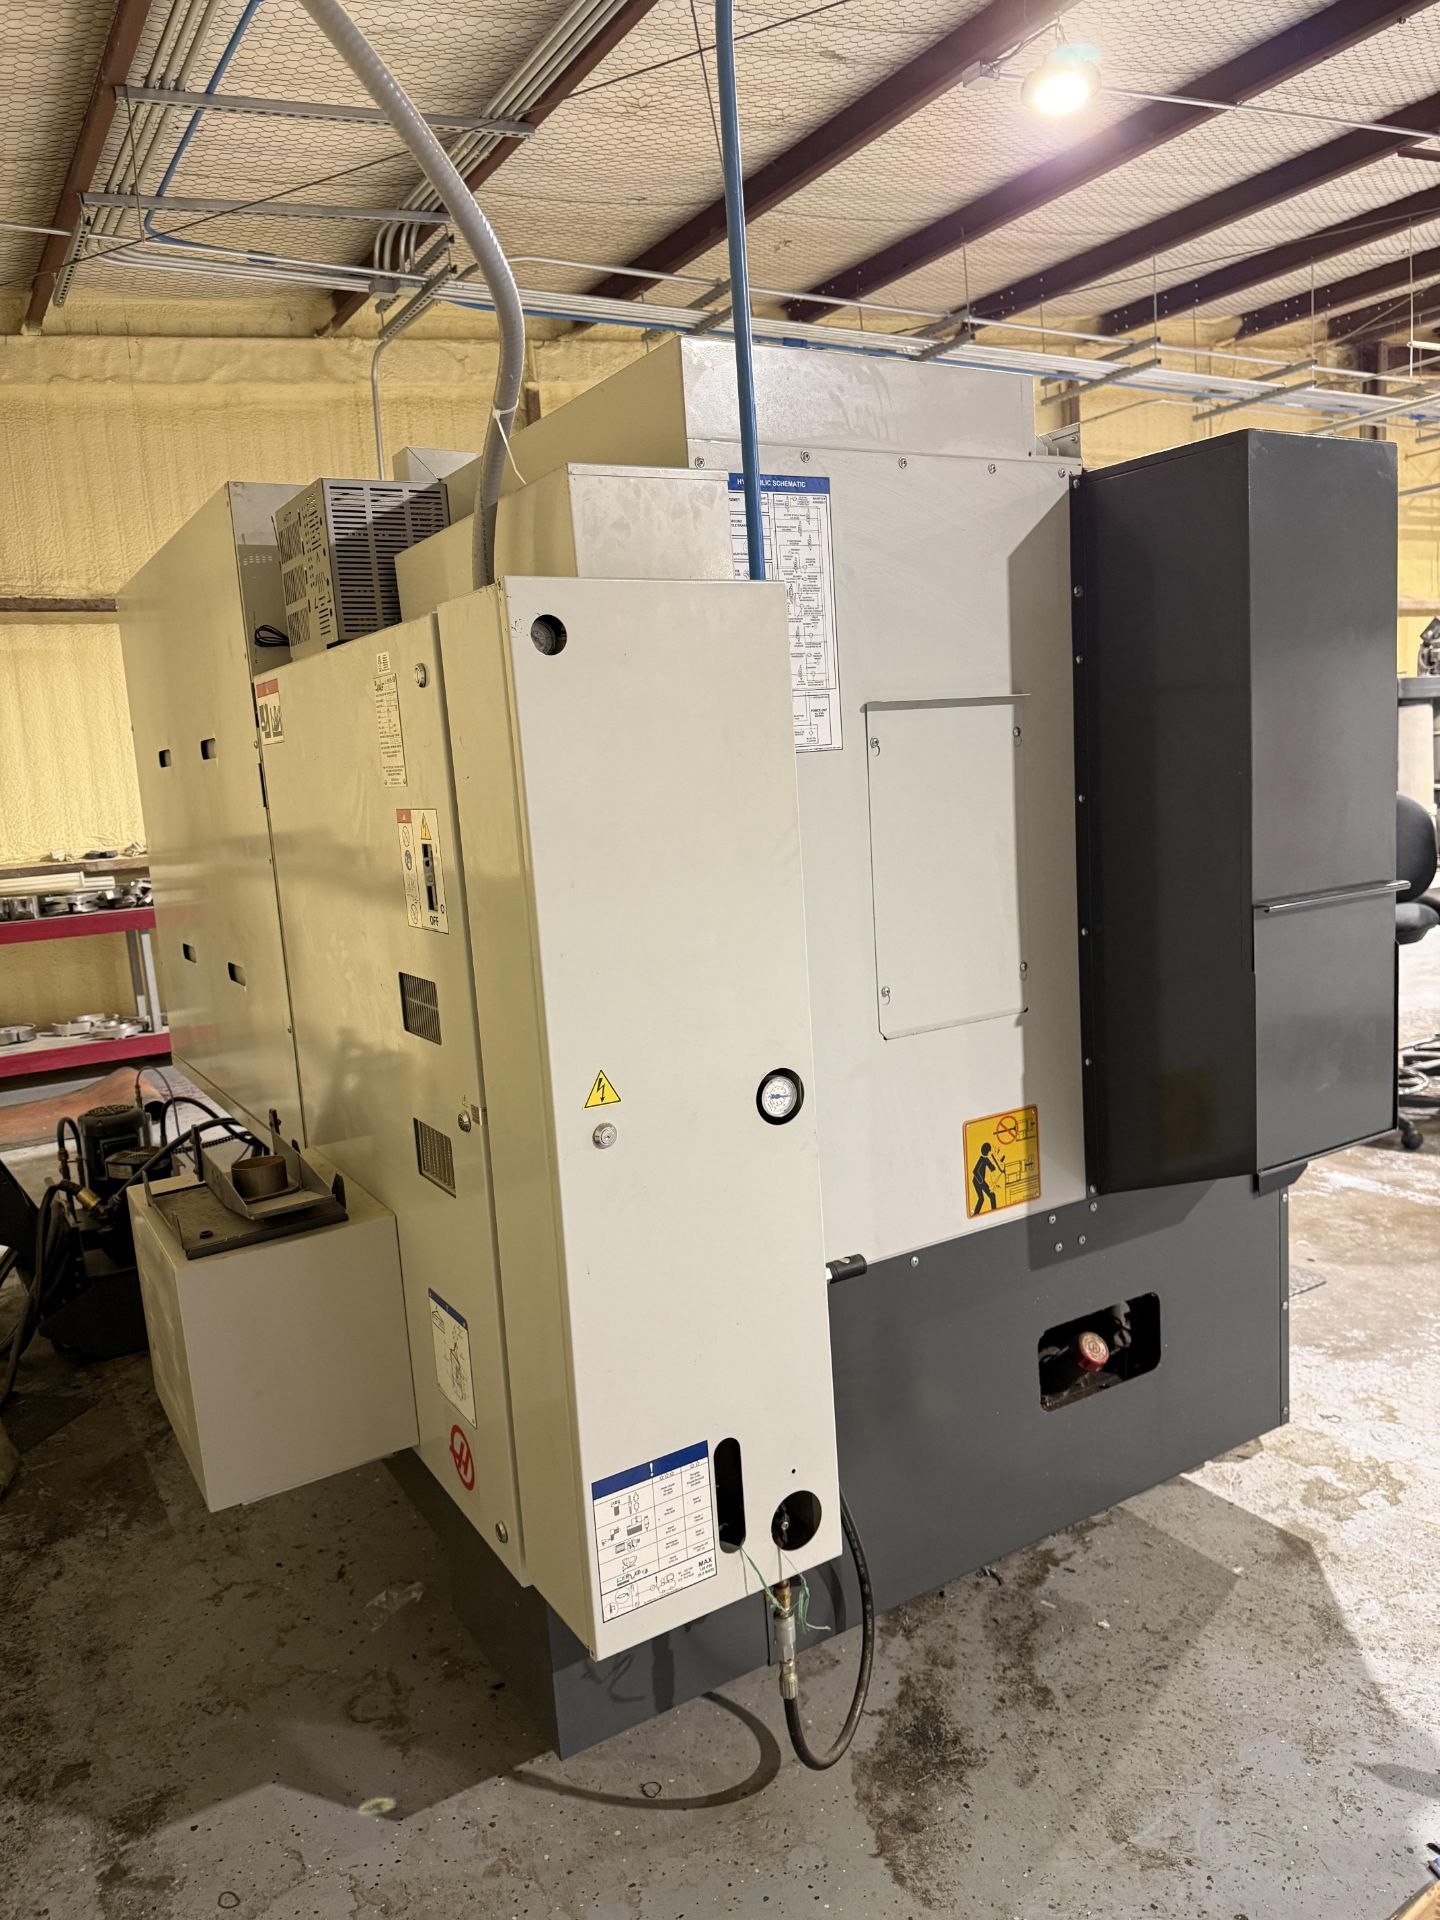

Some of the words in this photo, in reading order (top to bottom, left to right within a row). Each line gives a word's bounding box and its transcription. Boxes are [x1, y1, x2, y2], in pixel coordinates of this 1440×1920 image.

[772, 480, 807, 488] SCHEMATIC
[429, 915, 439, 926] OFF
[698, 1556, 713, 1567] MAX
